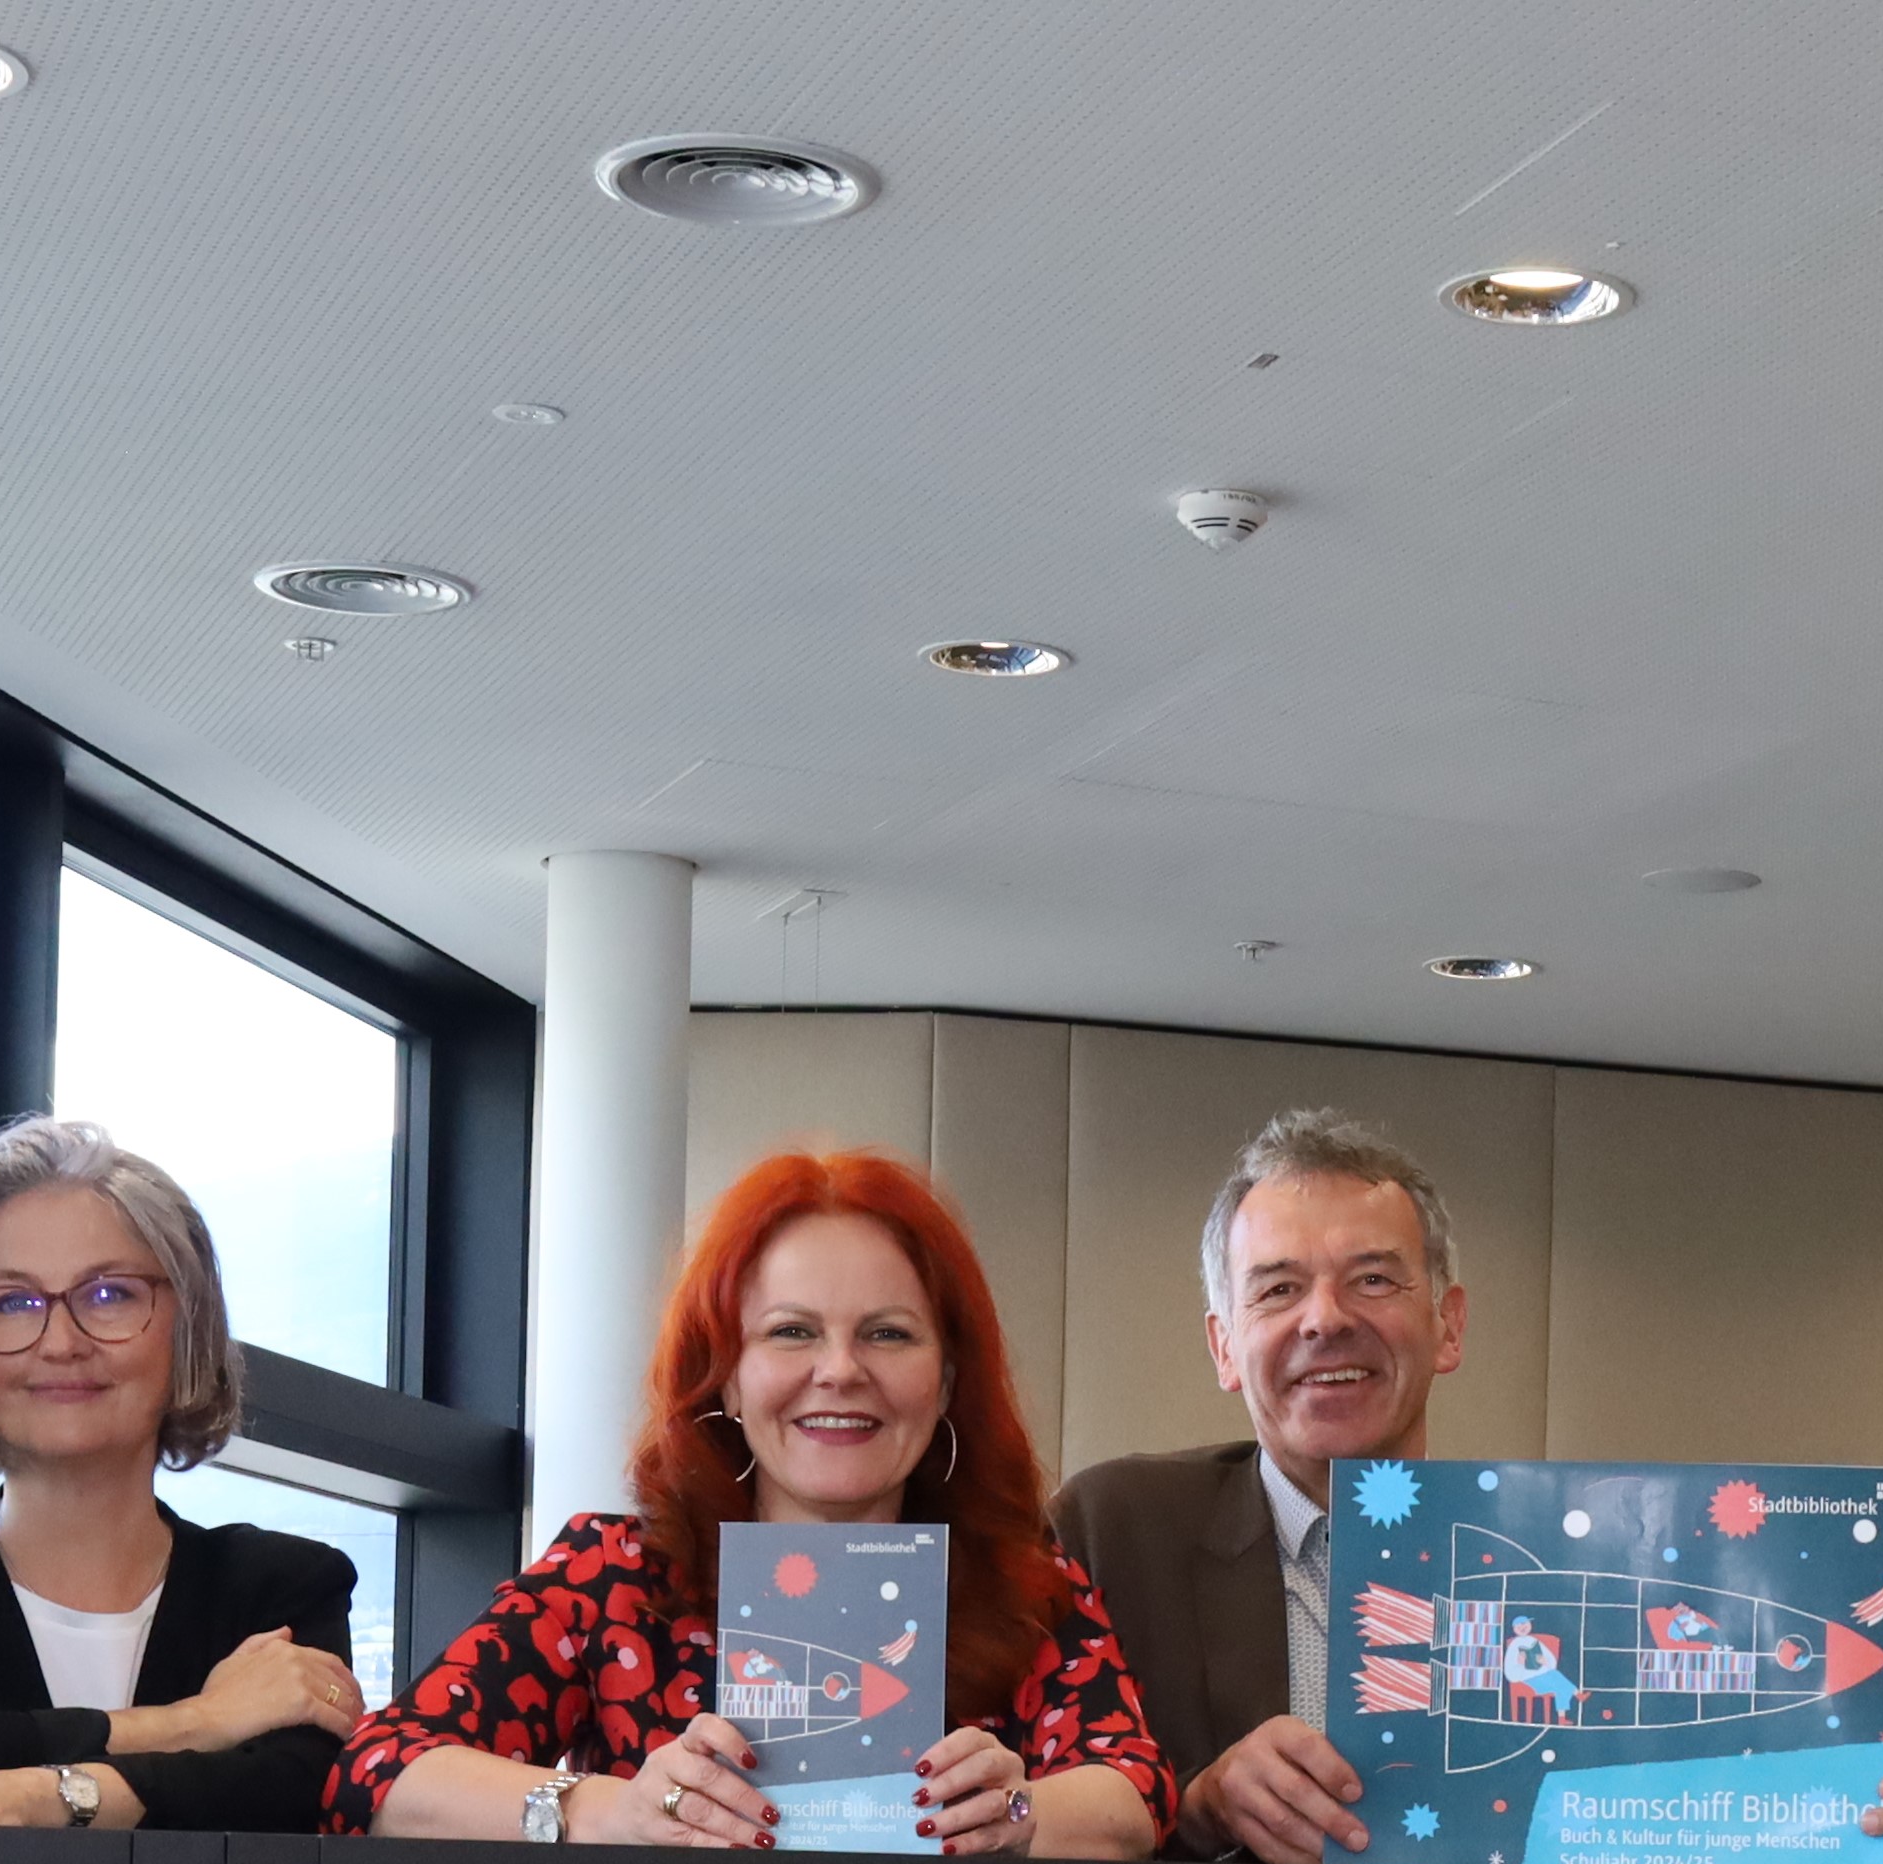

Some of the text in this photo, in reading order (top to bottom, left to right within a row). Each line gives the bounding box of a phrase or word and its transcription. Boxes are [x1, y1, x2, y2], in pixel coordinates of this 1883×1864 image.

[1748, 1496, 1878, 1515] Stadtbibliothek
[846, 1542, 916, 1553] Stadtbibliothek
[778, 1799, 925, 1819] mschiff Bibliothek
[1562, 1791, 1880, 1825] Raumschiff Bibliothe
[790, 1836, 828, 1845] 2024/25
[1560, 1828, 1840, 1852] Buch & Kultur für junge Menschen
